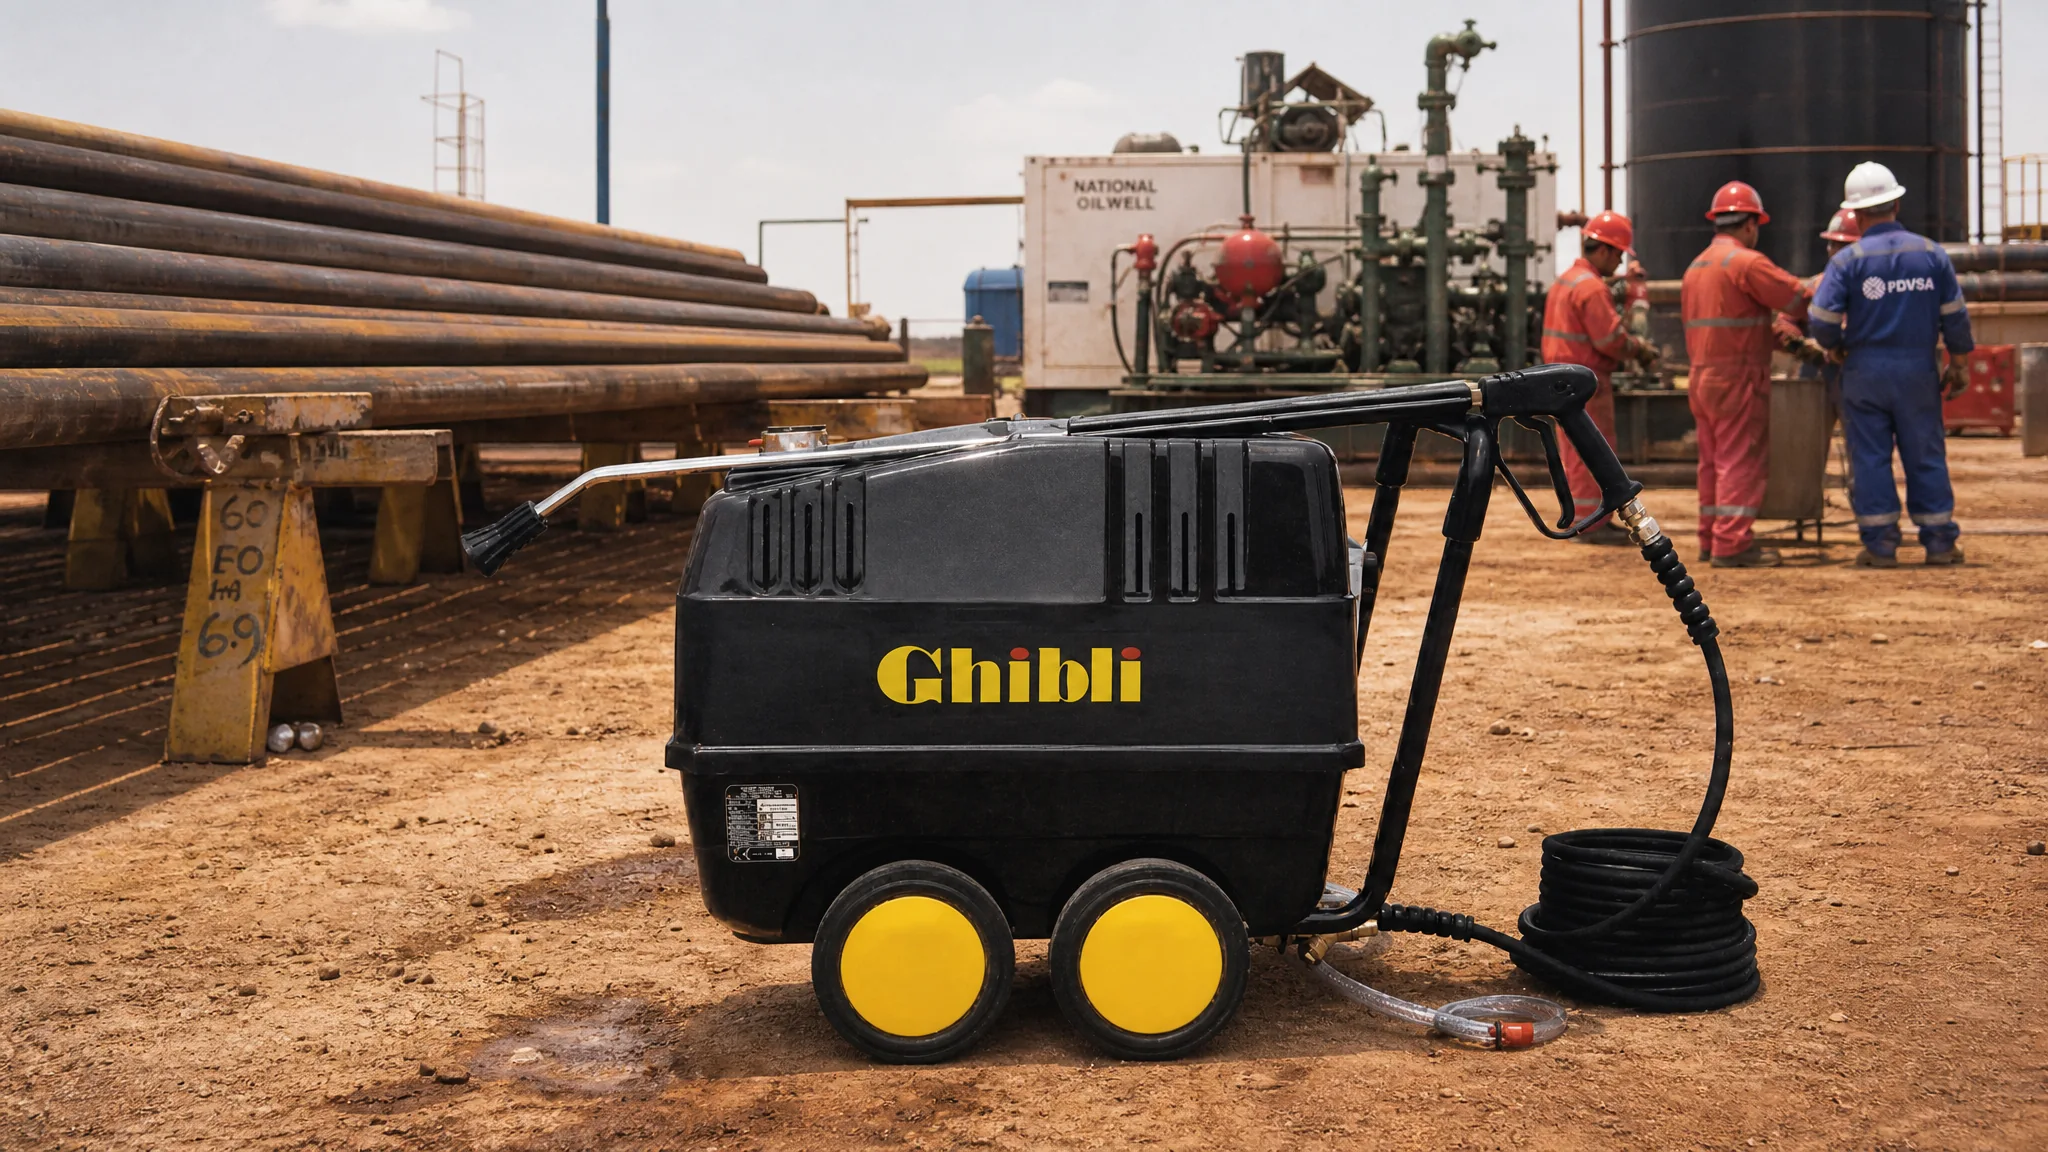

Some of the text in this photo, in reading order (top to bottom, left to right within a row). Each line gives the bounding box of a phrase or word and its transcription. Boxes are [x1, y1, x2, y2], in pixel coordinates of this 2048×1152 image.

[1074, 179, 1157, 193] NATIONAL
[1077, 196, 1154, 211] OILWELL
[1887, 277, 1935, 293] PDVSA
[220, 495, 268, 531] 60
[877, 645, 1142, 705] Ghibli
